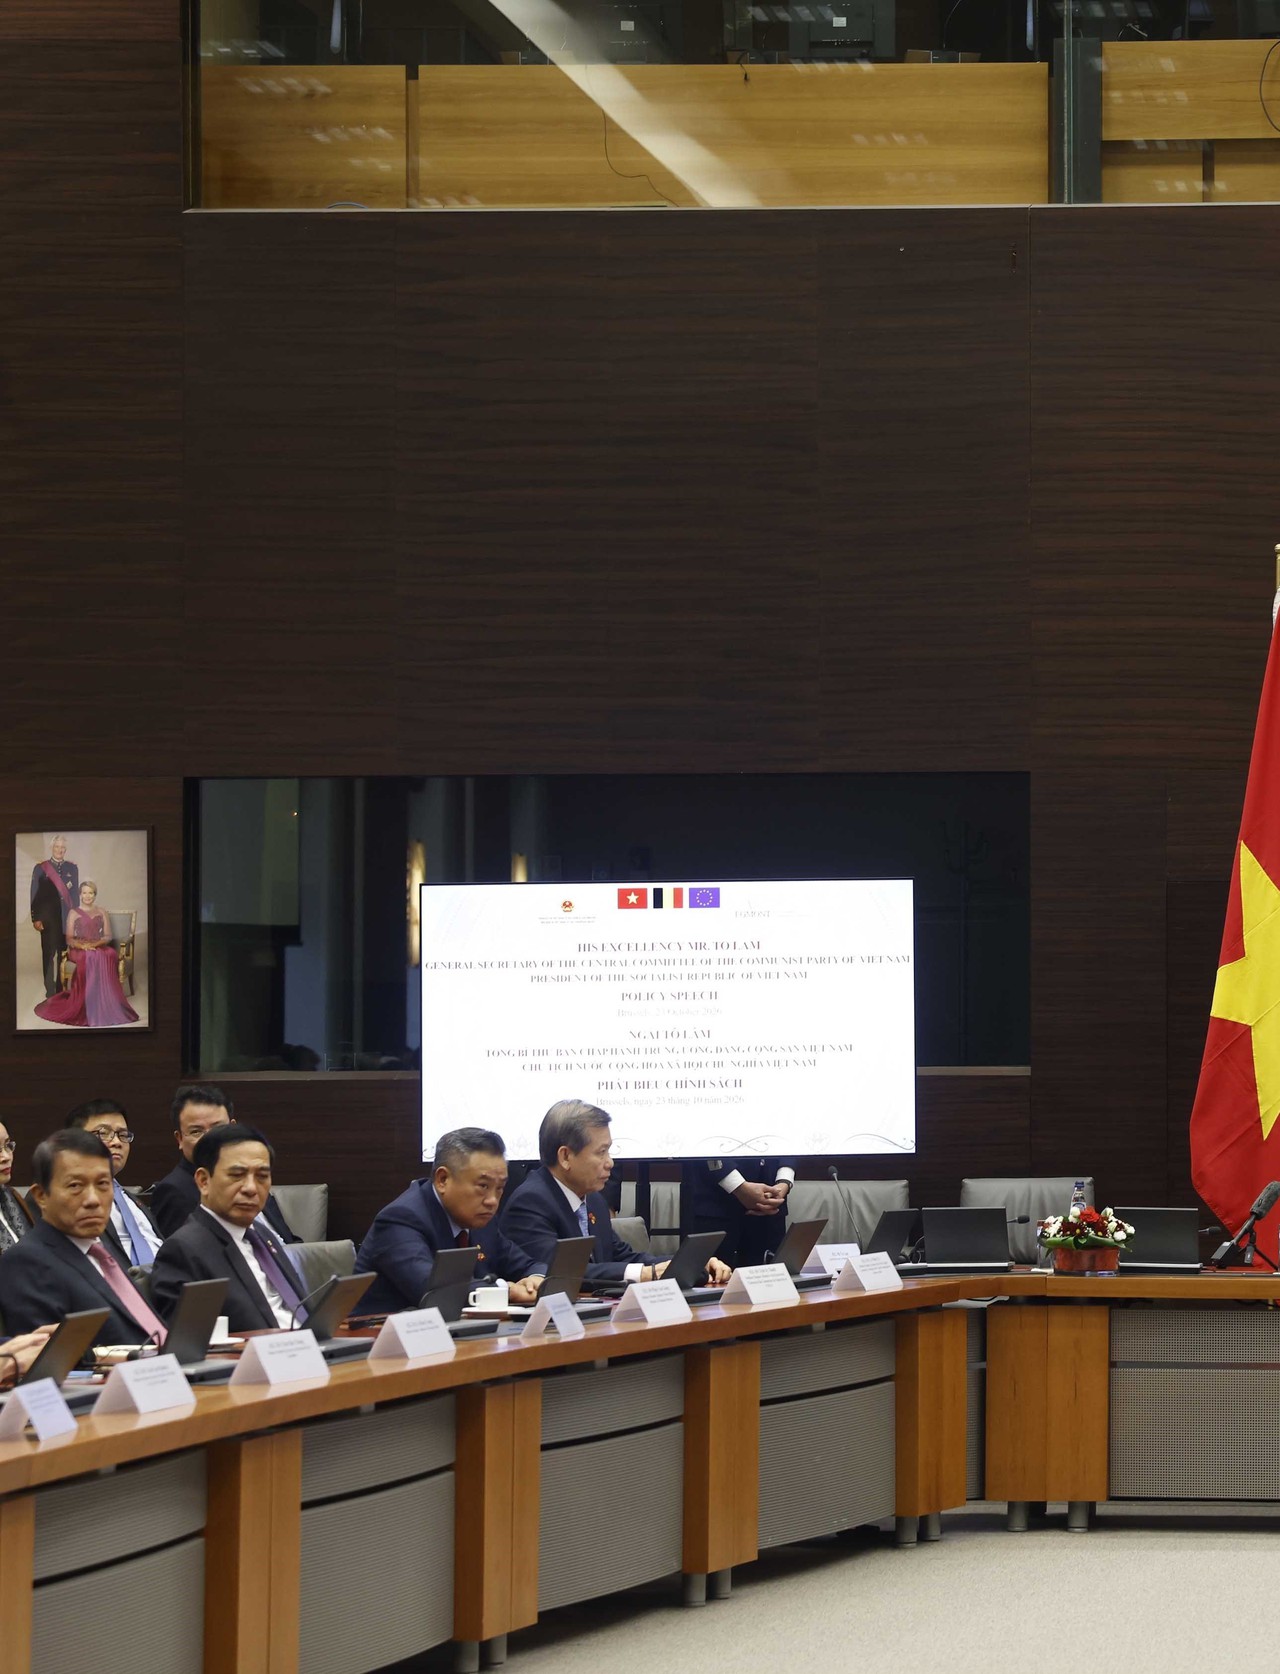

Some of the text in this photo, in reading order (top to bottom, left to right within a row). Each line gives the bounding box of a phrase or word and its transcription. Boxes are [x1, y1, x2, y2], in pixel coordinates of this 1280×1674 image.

[578, 940, 761, 952] HIS EXCELLENCY MR. TO LAM
[424, 955, 910, 970] GENERAL SECRETARY OF THE CENTRAL COMMITTEE OF THE COMMUNIST PARTY OF VIET NAM
[530, 974, 587, 983] PRESIDENT
[590, 974, 604, 982] OF
[607, 973, 627, 982] THE
[630, 972, 683, 981] SOCIALIST
[687, 972, 736, 981] REPUBLIC
[757, 971, 781, 980] VIET
[783, 971, 808, 979] NAM
[621, 991, 719, 1001] POLICY SPEECH
[555, 1048, 578, 1057] BAN
[643, 1046, 680, 1055] TRUNG
[829, 1043, 853, 1052] NAM
[792, 1058, 816, 1067] NAM
